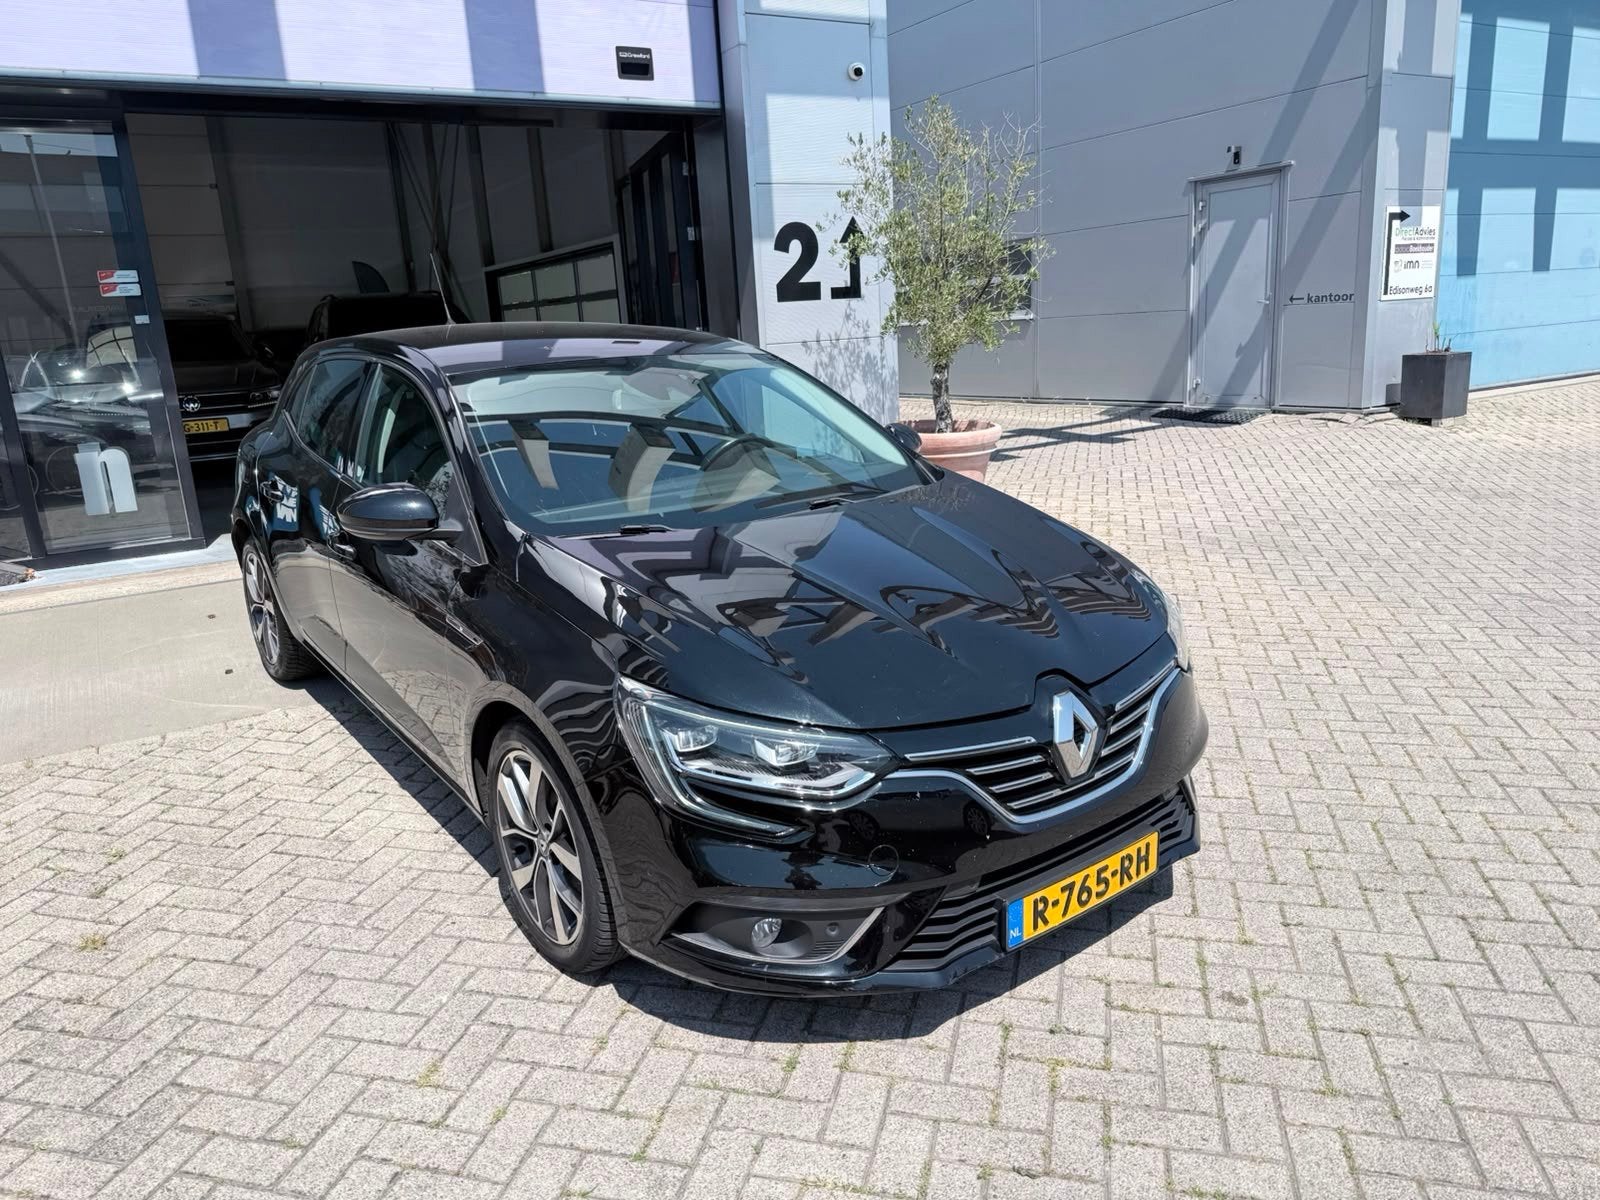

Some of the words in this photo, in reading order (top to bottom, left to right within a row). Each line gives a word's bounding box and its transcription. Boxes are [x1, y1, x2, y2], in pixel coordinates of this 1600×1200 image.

[1389, 285, 1423, 296] Edisonweg
[1307, 293, 1355, 304] kantoor
[1032, 841, 1151, 931] R-765-RH
[1009, 927, 1022, 939] NL
